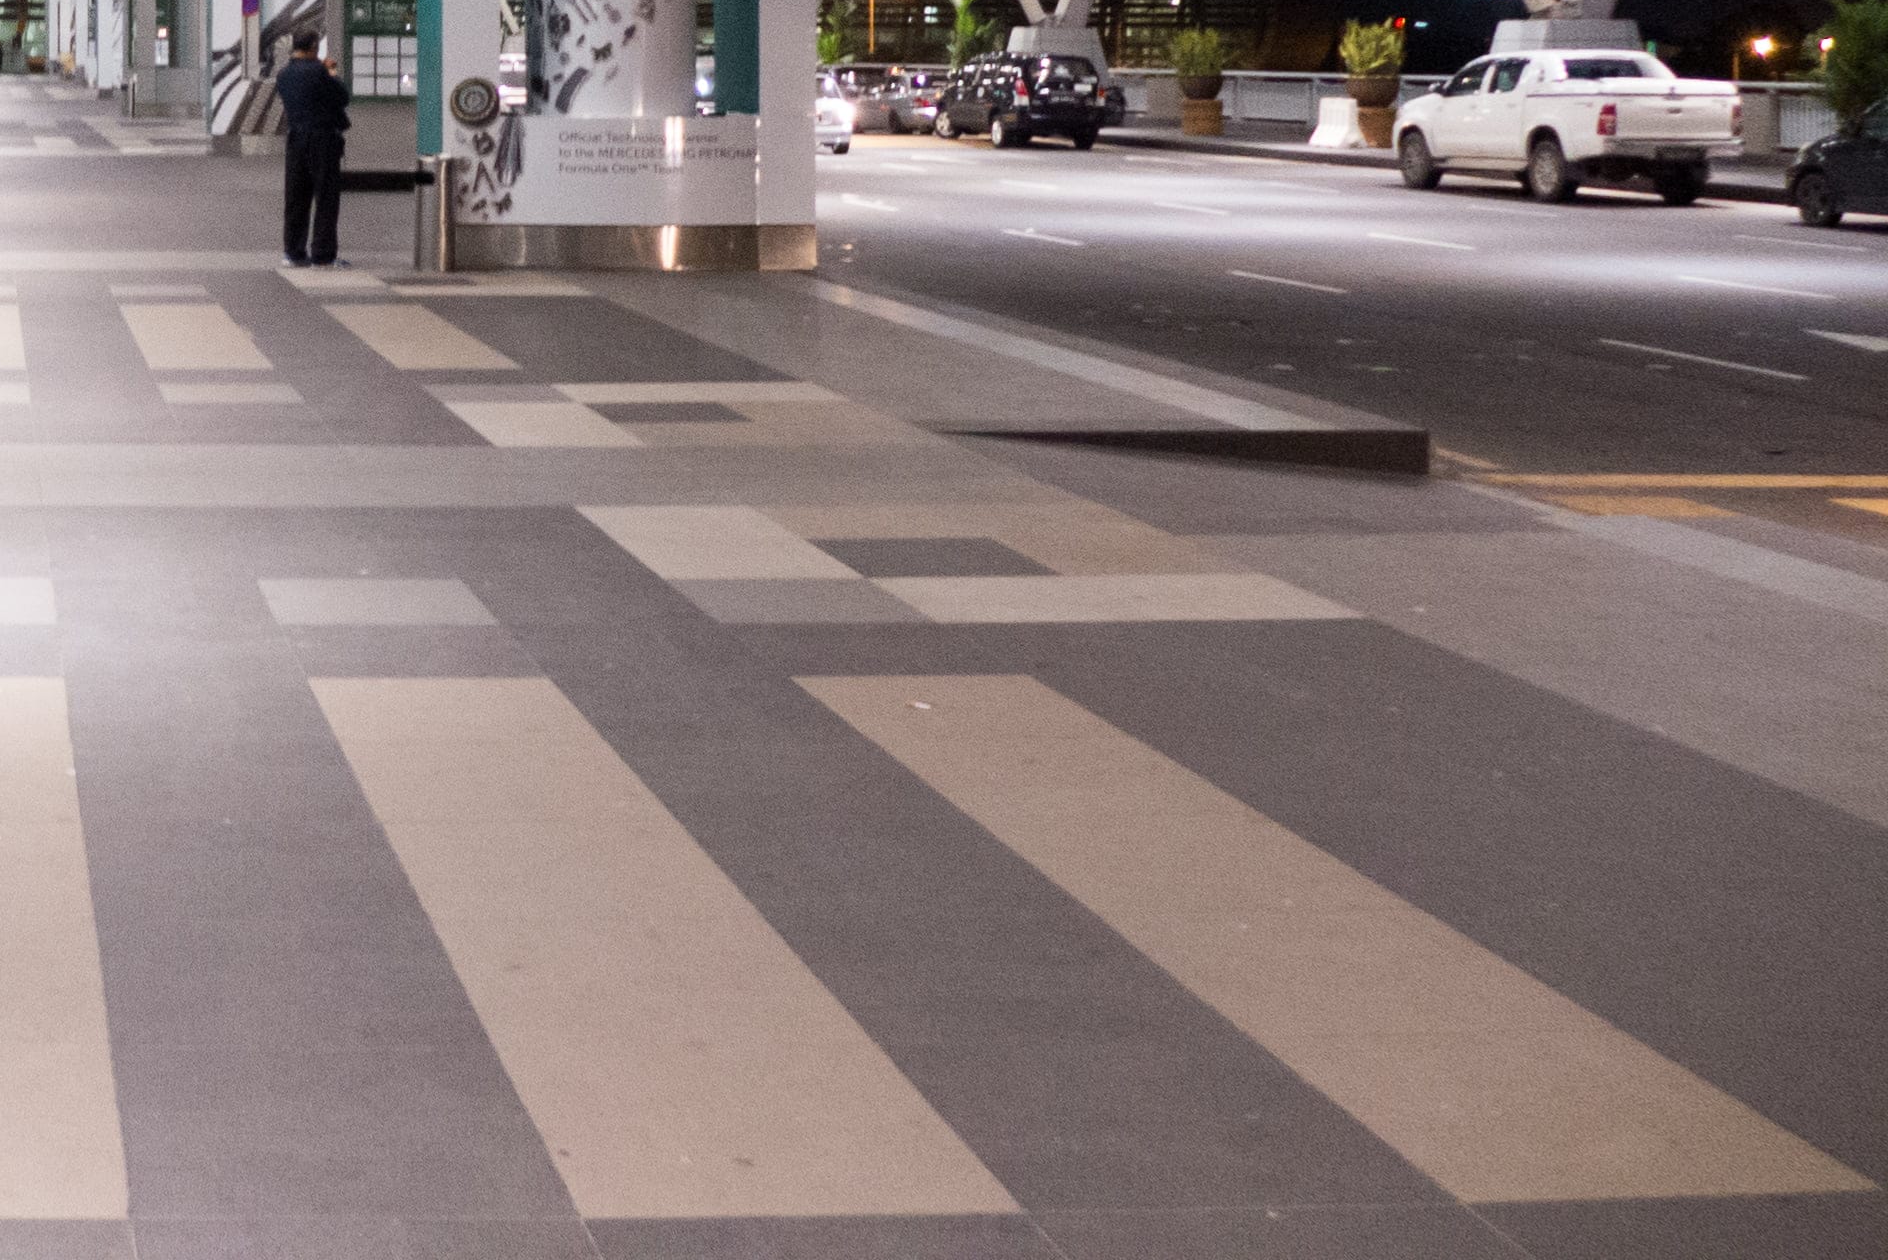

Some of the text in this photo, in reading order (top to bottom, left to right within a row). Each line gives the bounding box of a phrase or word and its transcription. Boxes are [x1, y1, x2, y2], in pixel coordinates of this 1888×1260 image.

[558, 131, 601, 143] Official
[606, 131, 670, 146] Technolog
[558, 148, 572, 158] to
[575, 148, 594, 158] the
[558, 162, 608, 174] Formula
